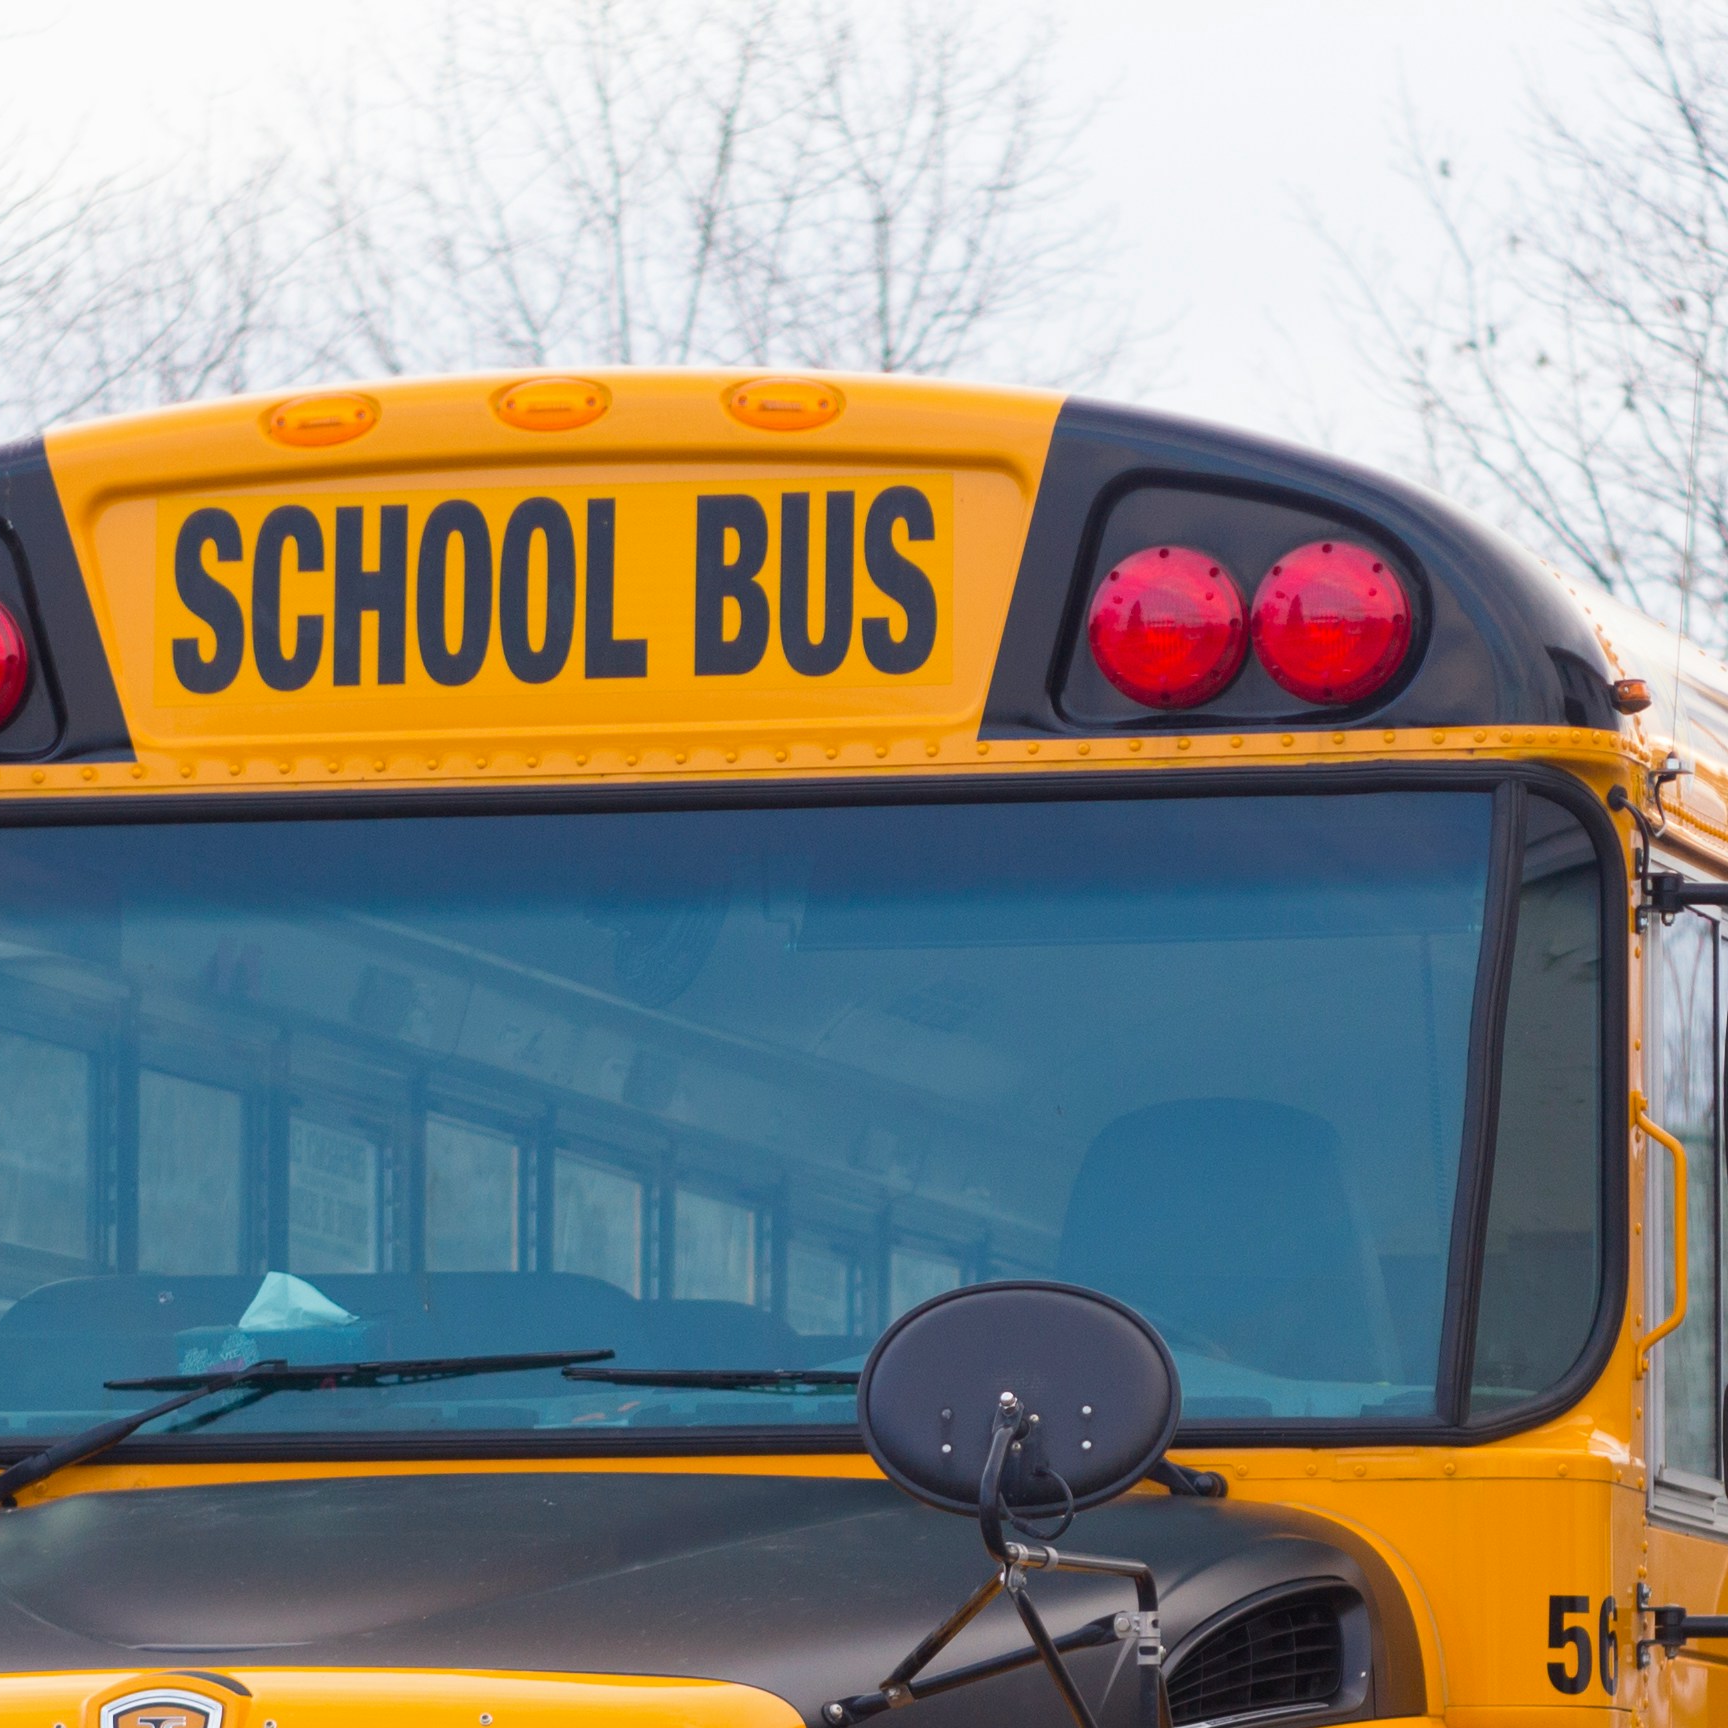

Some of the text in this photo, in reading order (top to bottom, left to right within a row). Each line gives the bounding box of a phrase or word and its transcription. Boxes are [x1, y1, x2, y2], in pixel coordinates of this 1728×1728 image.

[171, 484, 938, 695] SCHOOL BUS
[1547, 1595, 1618, 1696] 56
